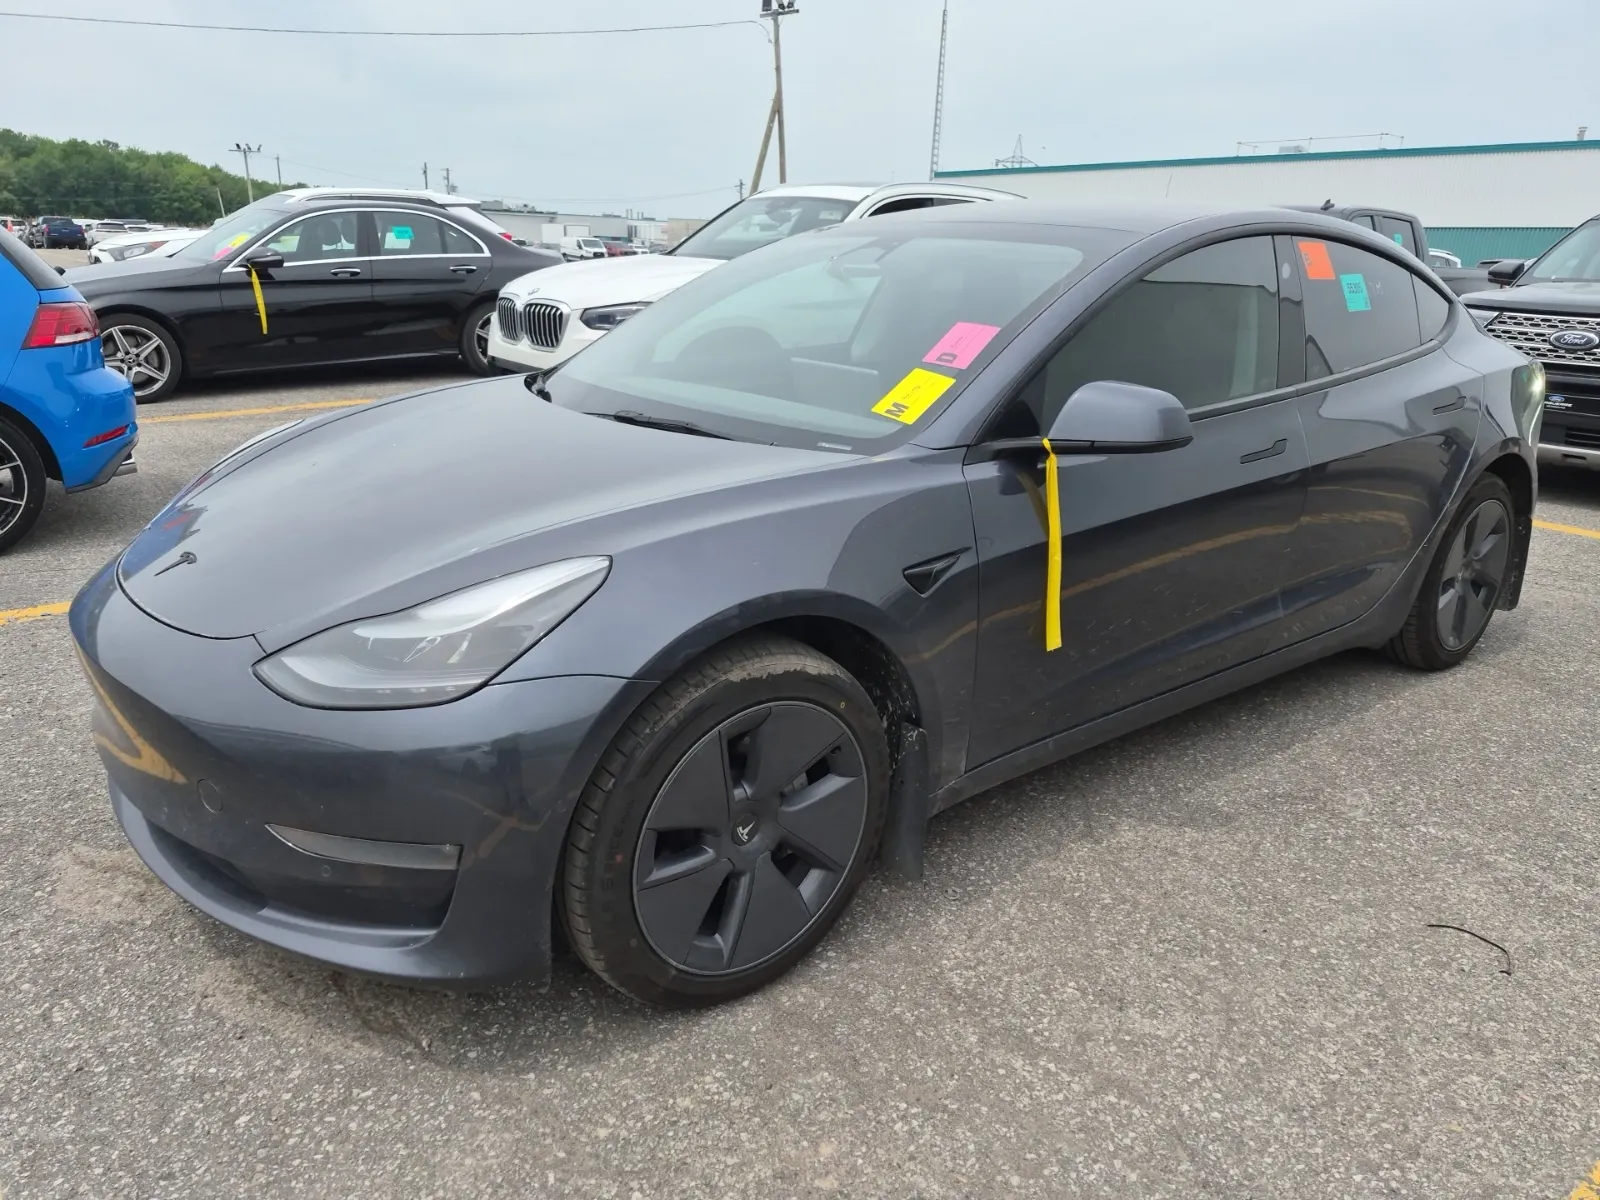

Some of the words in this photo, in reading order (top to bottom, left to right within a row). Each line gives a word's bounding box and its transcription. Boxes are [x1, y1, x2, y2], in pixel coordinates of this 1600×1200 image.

[1560, 333, 1588, 345] Ford
[935, 352, 958, 364] D
[885, 401, 910, 418] M
